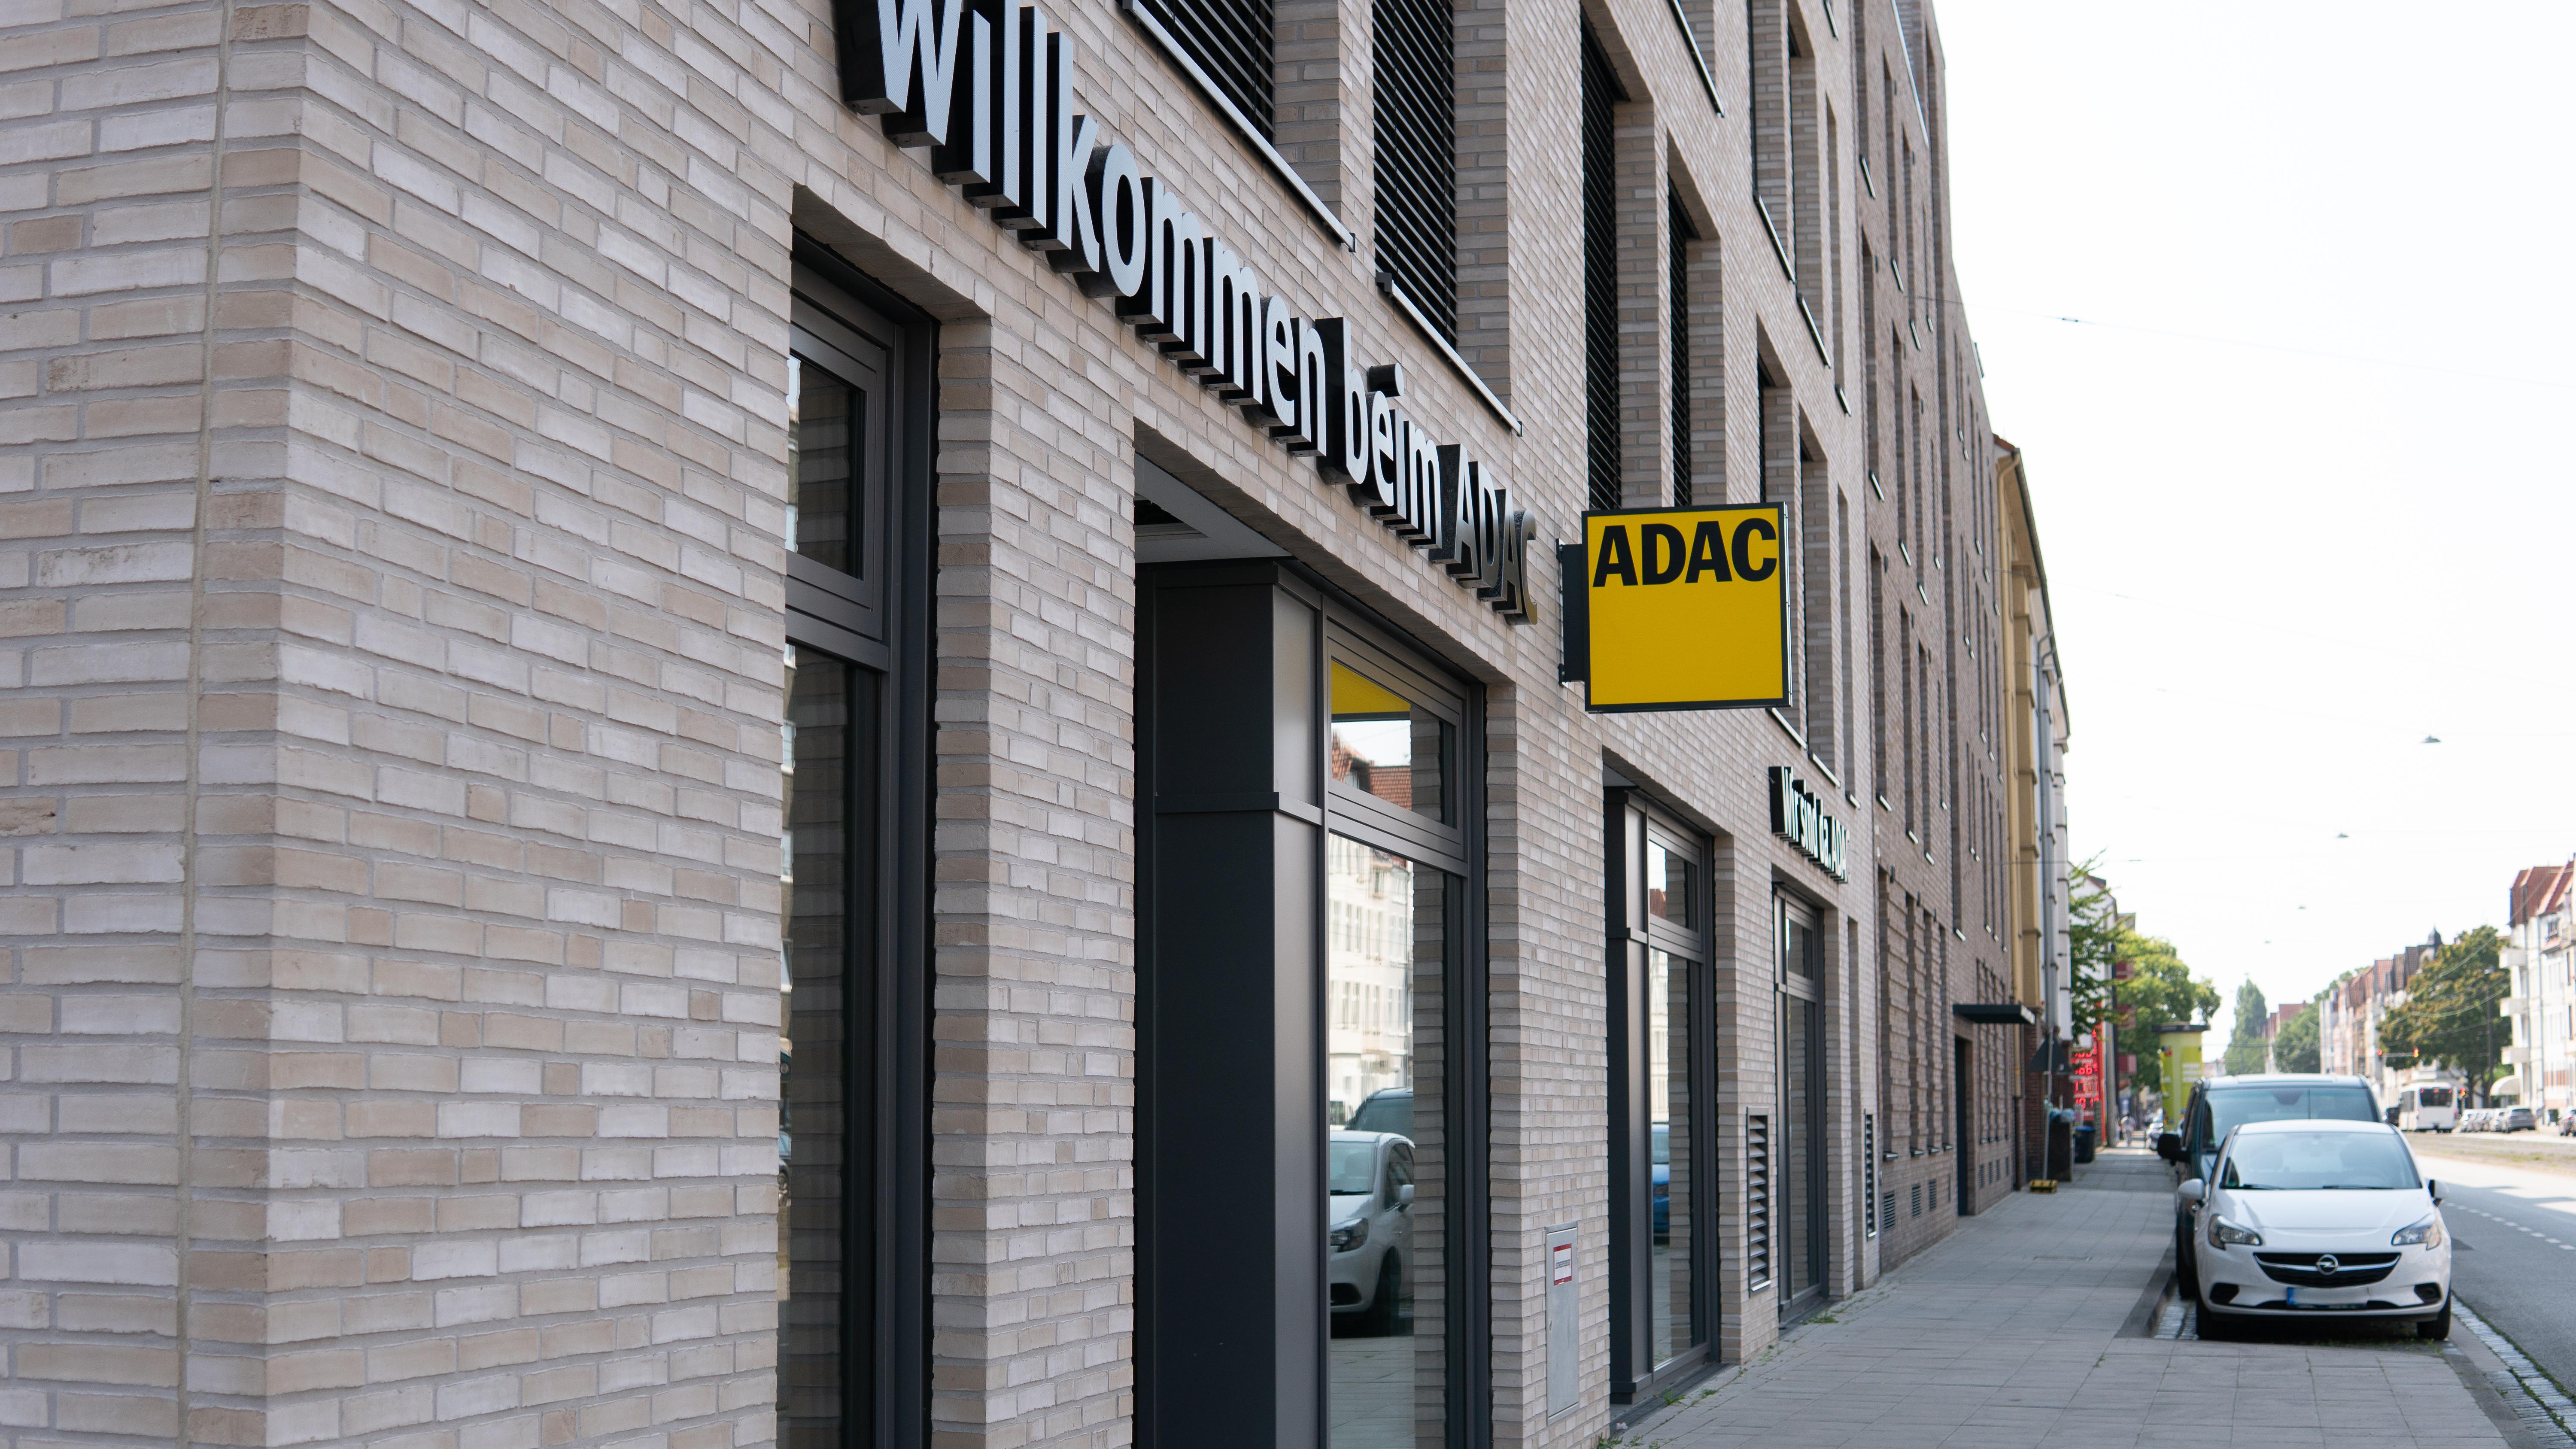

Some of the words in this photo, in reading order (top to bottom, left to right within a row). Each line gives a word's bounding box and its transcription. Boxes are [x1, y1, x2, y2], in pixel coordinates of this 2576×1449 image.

[1341, 316, 1443, 550] beim
[1454, 444, 1538, 625] ADAC
[1593, 518, 1777, 587] ADAC
[1781, 766, 1799, 842] Wir
[1800, 778, 1819, 859] sind
